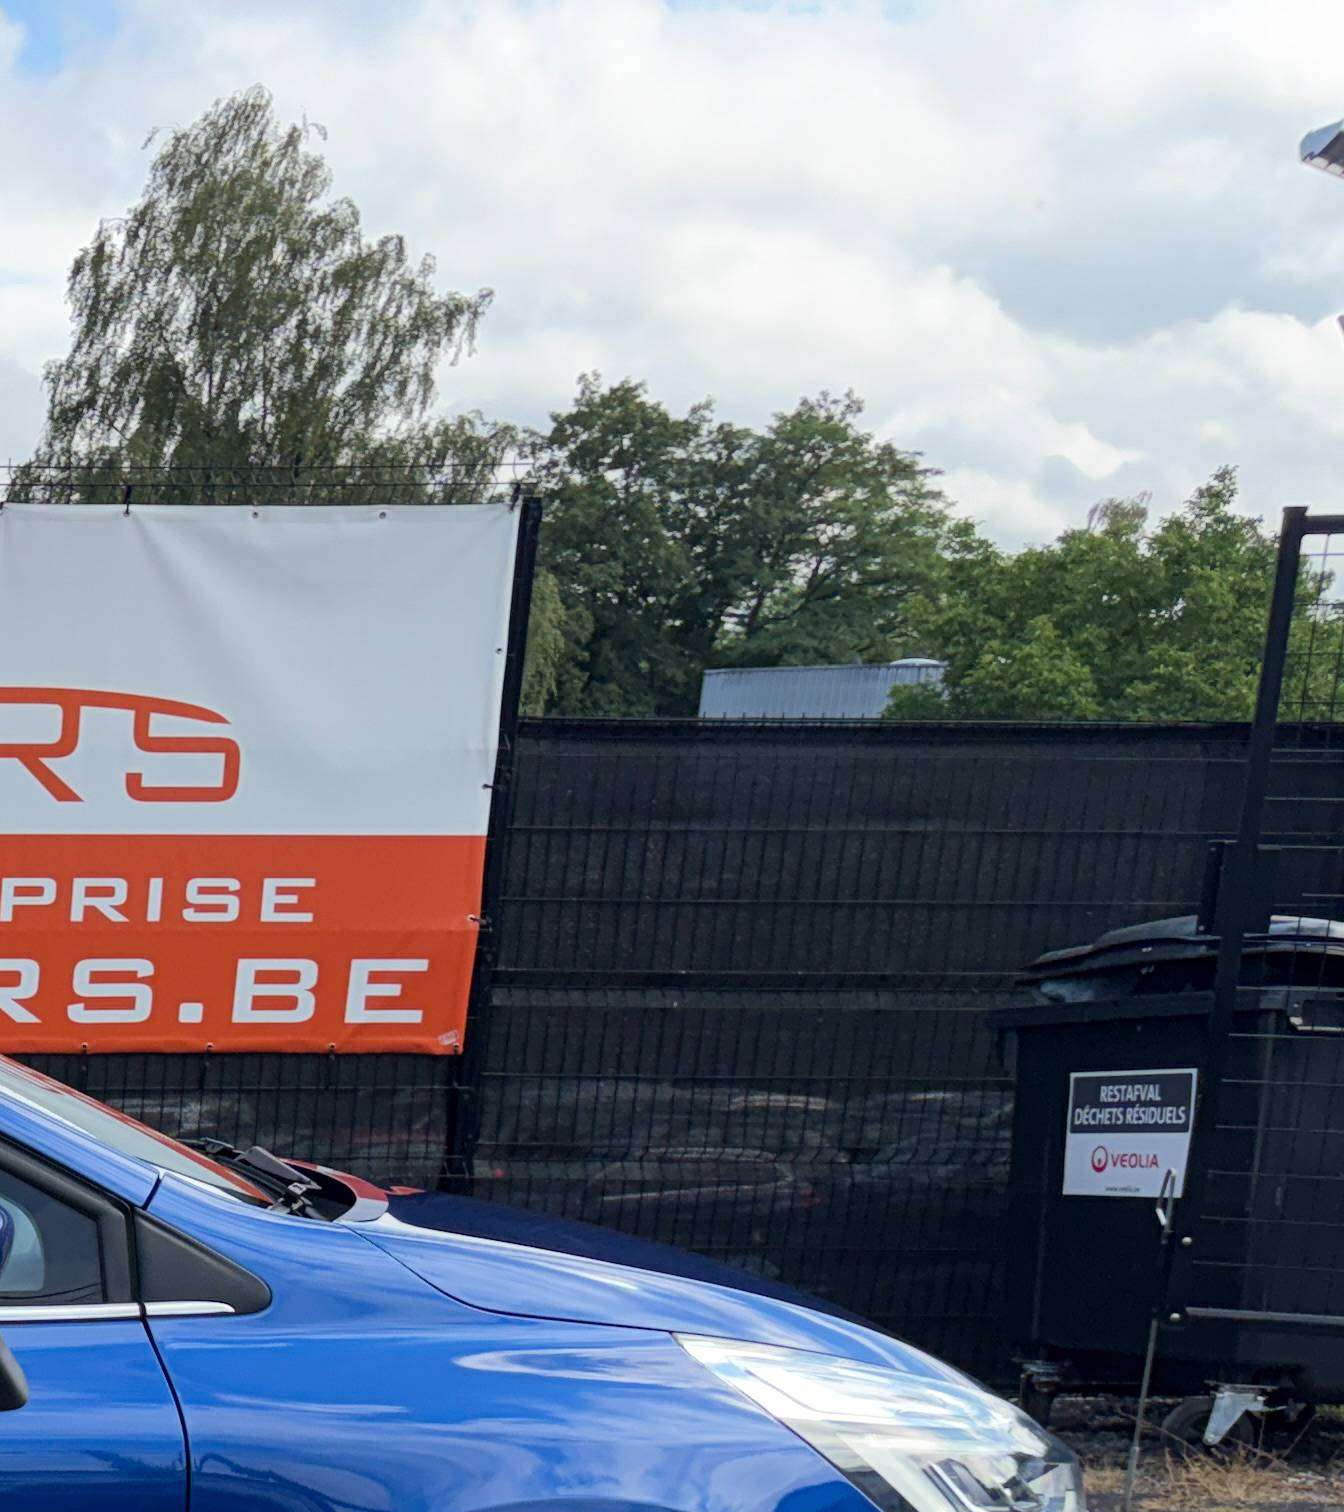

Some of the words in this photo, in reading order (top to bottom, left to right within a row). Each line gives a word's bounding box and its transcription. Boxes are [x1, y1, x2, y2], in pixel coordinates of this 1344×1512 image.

[1100, 1084, 1161, 1102] RESTAFVAL
[1074, 1104, 1124, 1125] DÉCHETS
[1126, 1104, 1186, 1124] RÉSIDUELS
[1111, 1153, 1159, 1169] VEOLIA
